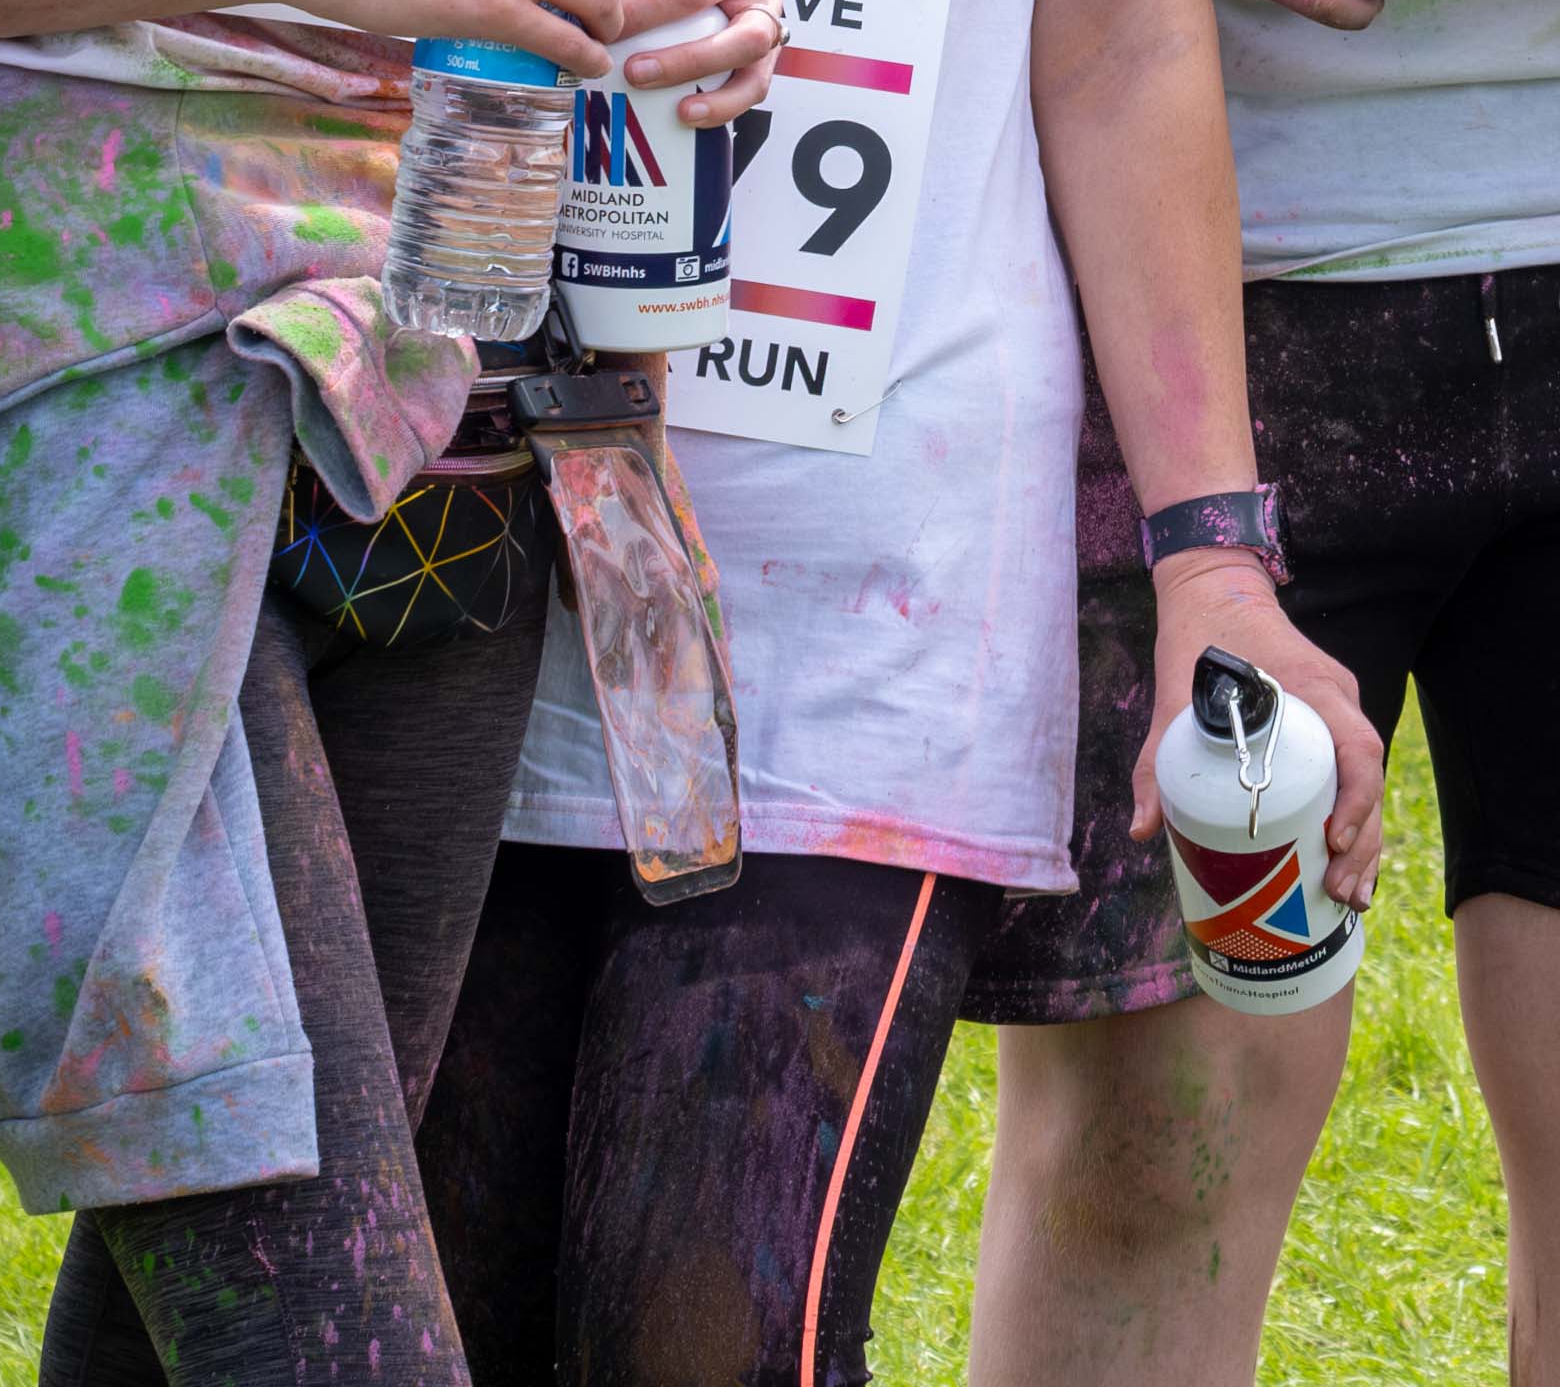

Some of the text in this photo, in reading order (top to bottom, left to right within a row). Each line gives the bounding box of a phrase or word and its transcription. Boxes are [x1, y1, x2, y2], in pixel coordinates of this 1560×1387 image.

[446, 54, 464, 68] 500
[571, 189, 644, 207] MIDLAND
[612, 228, 664, 241] HOSPITAL
[584, 262, 646, 279] SWBHnhs
[696, 337, 829, 396] RUN
[1232, 946, 1327, 976] MidlandMetUH
